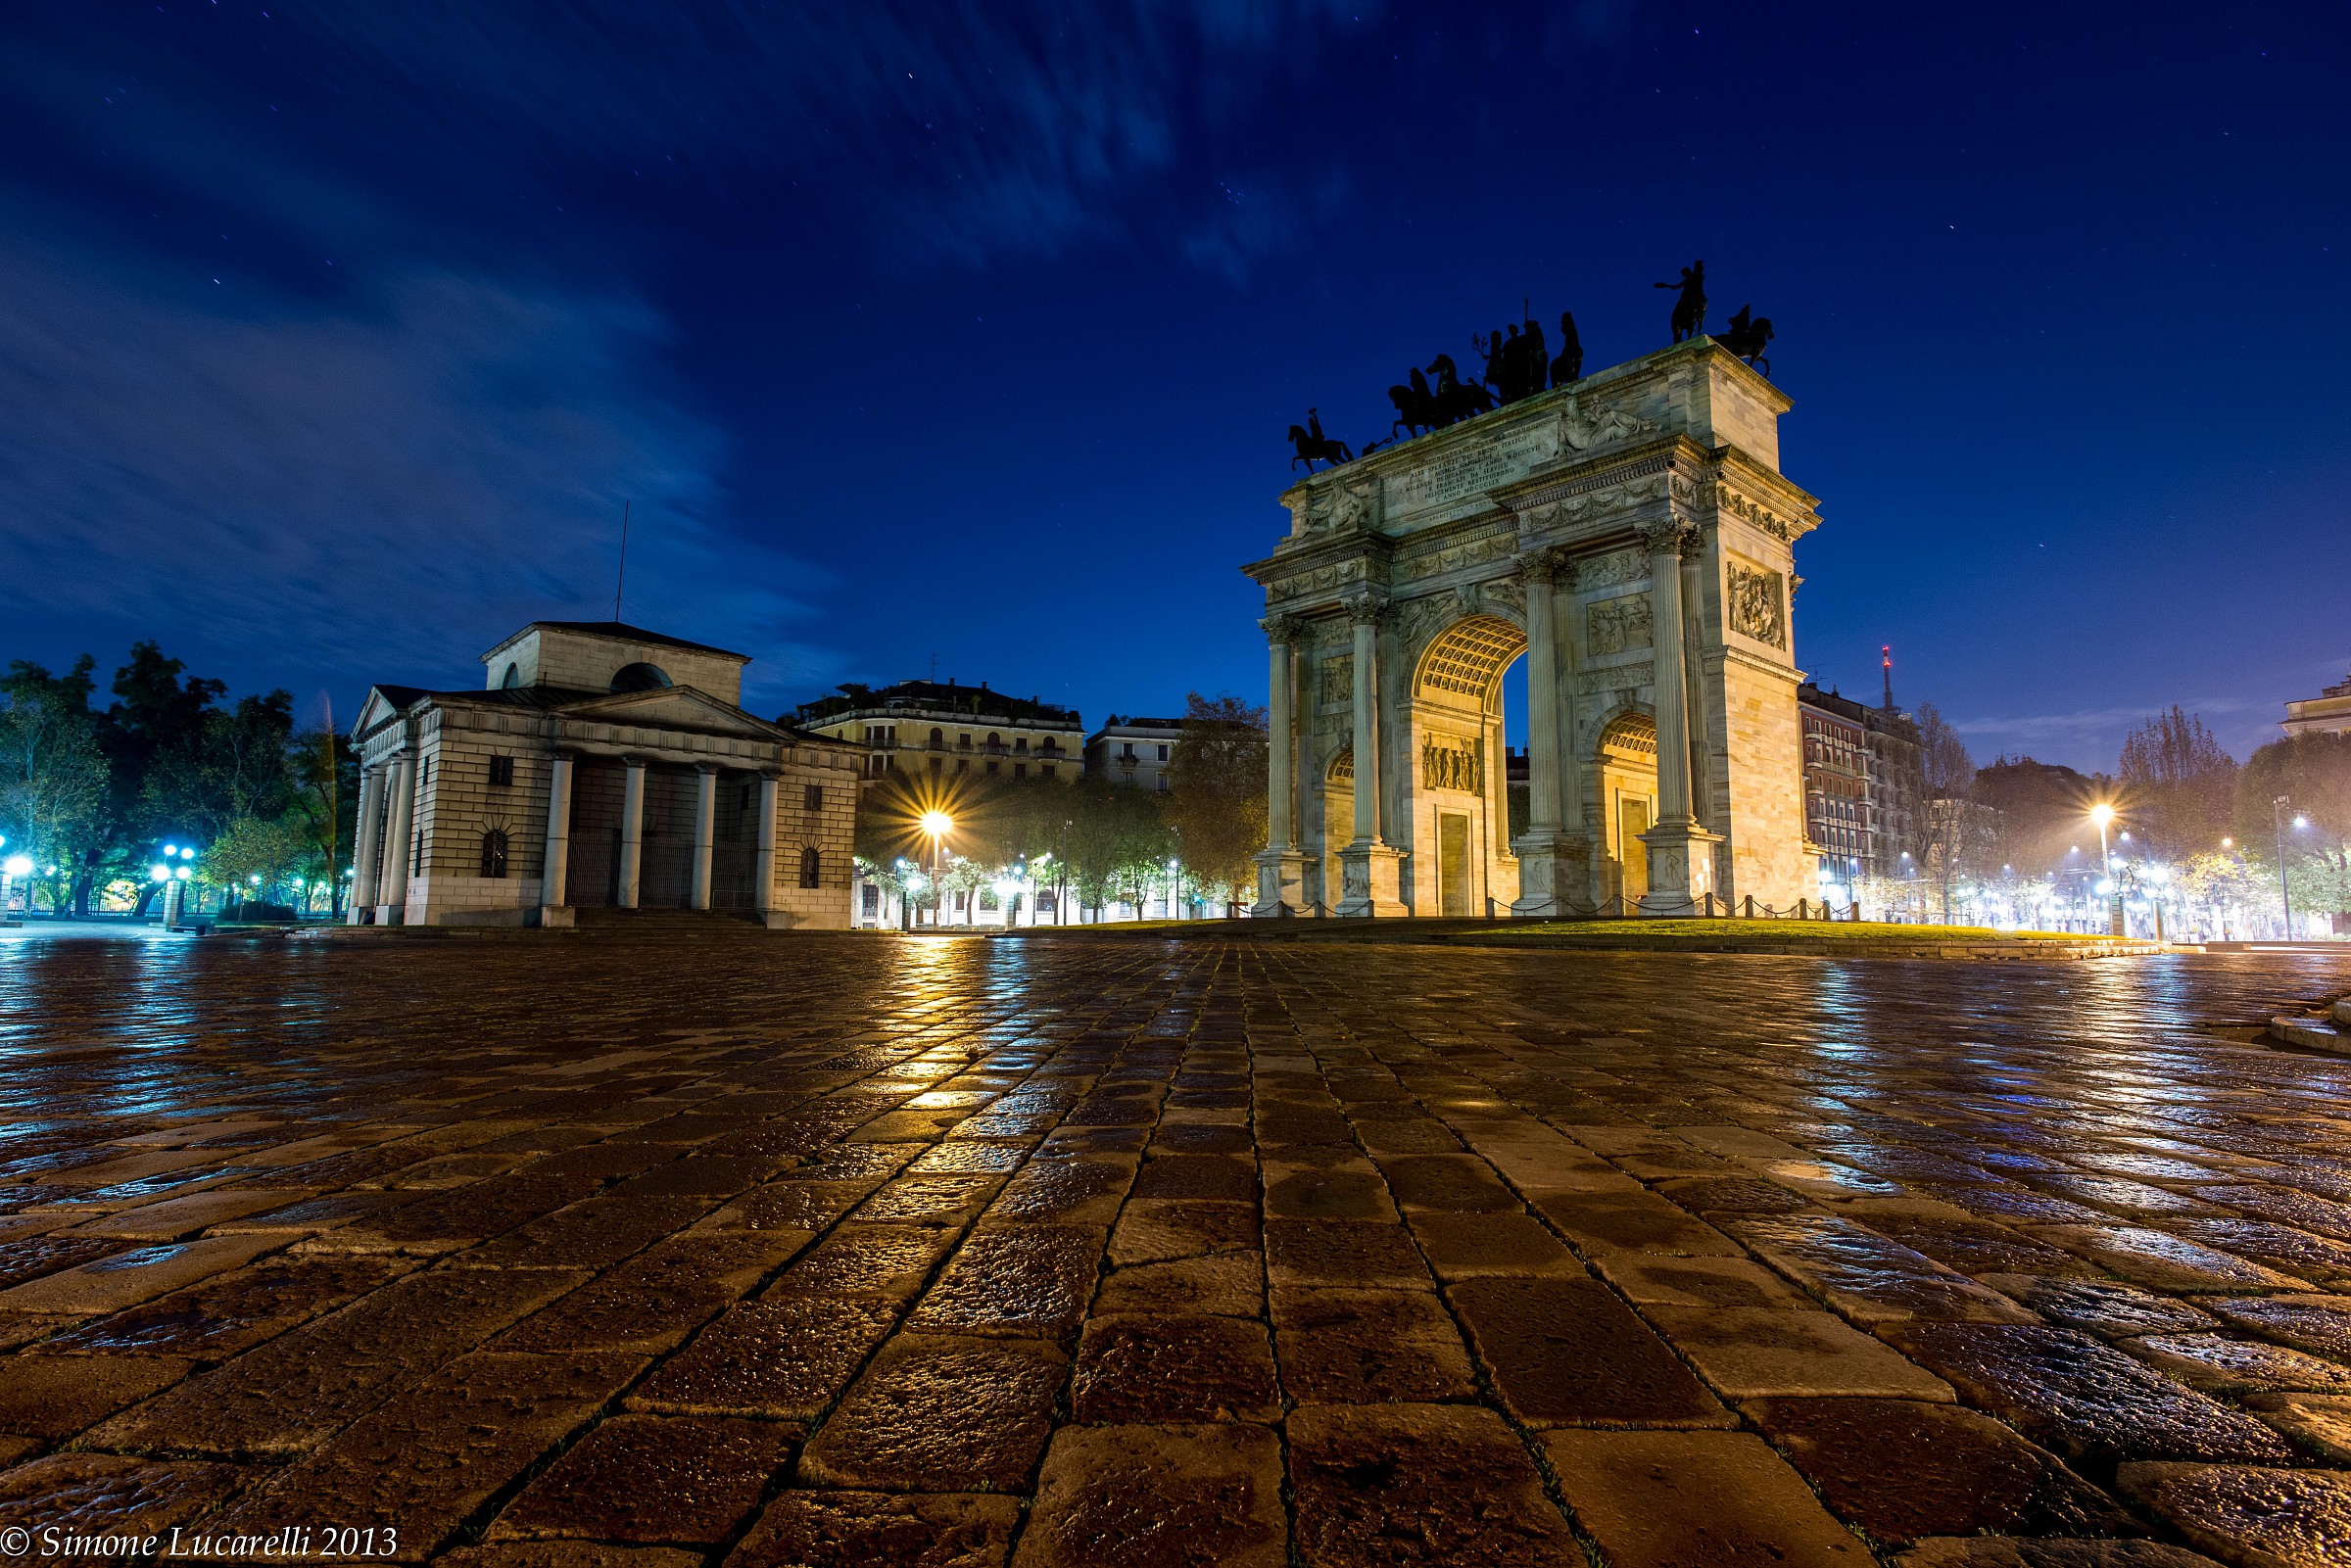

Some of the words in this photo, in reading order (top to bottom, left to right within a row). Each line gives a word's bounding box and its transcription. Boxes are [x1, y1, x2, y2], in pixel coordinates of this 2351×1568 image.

[1428, 459, 1458, 472] SPERANZE
[1477, 446, 1498, 456] REGNO
[1502, 436, 1526, 449] ITALICO
[1460, 454, 1492, 468] NAPOLEONE
[1437, 466, 1475, 482] DEDICARONO
[1507, 445, 1541, 459] MDCCCVII
[1425, 483, 1463, 499] FELICEMENTE
[1467, 467, 1514, 486] RESTITUIRONO
[1436, 476, 1465, 489] FRANCATI
[1464, 479, 1500, 494] MDCCCLIX
[1429, 508, 1463, 521] ARCHITETTO
